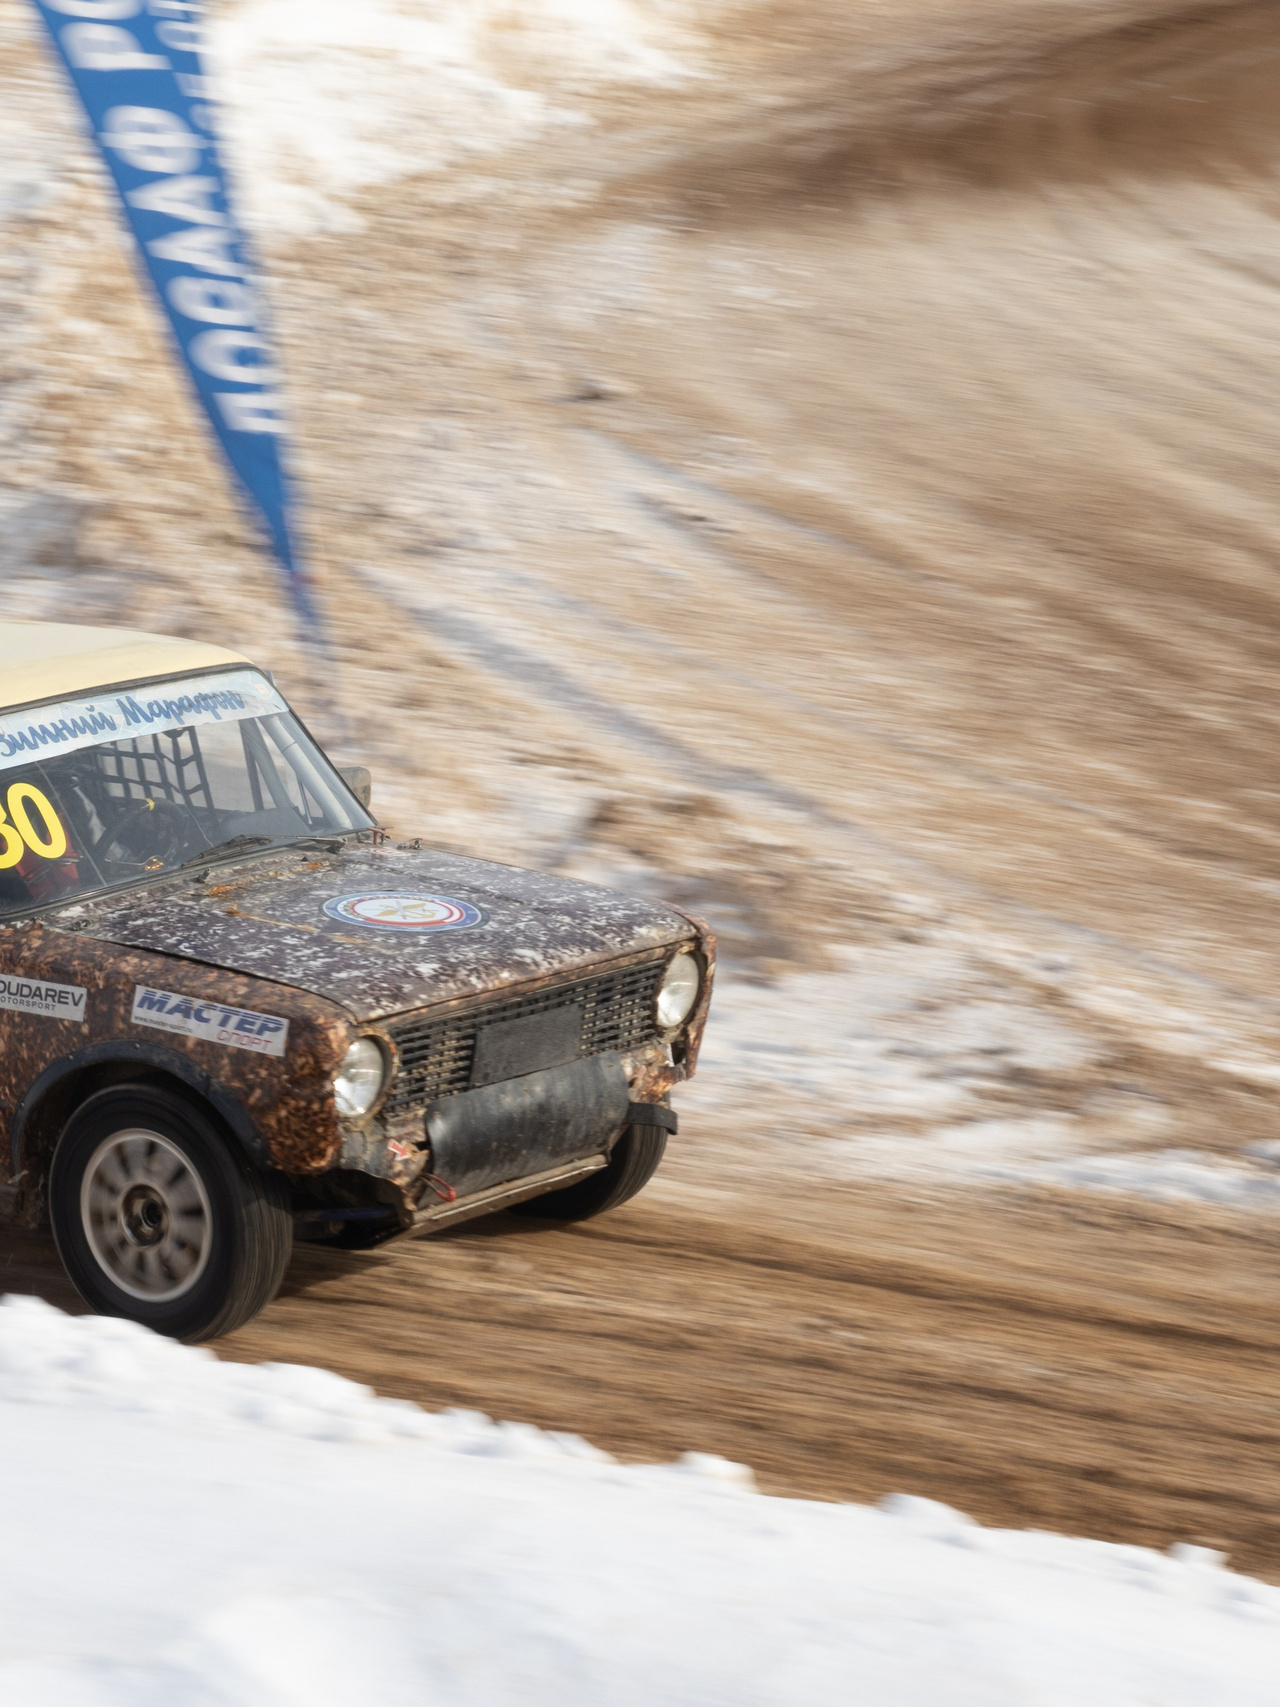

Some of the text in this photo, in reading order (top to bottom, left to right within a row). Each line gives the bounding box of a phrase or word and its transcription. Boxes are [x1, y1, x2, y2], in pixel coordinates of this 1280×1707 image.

[116, 689, 246, 726] Марафон
[137, 989, 285, 1037] МАСТЕР
[216, 1029, 273, 1051] СПОРТ
